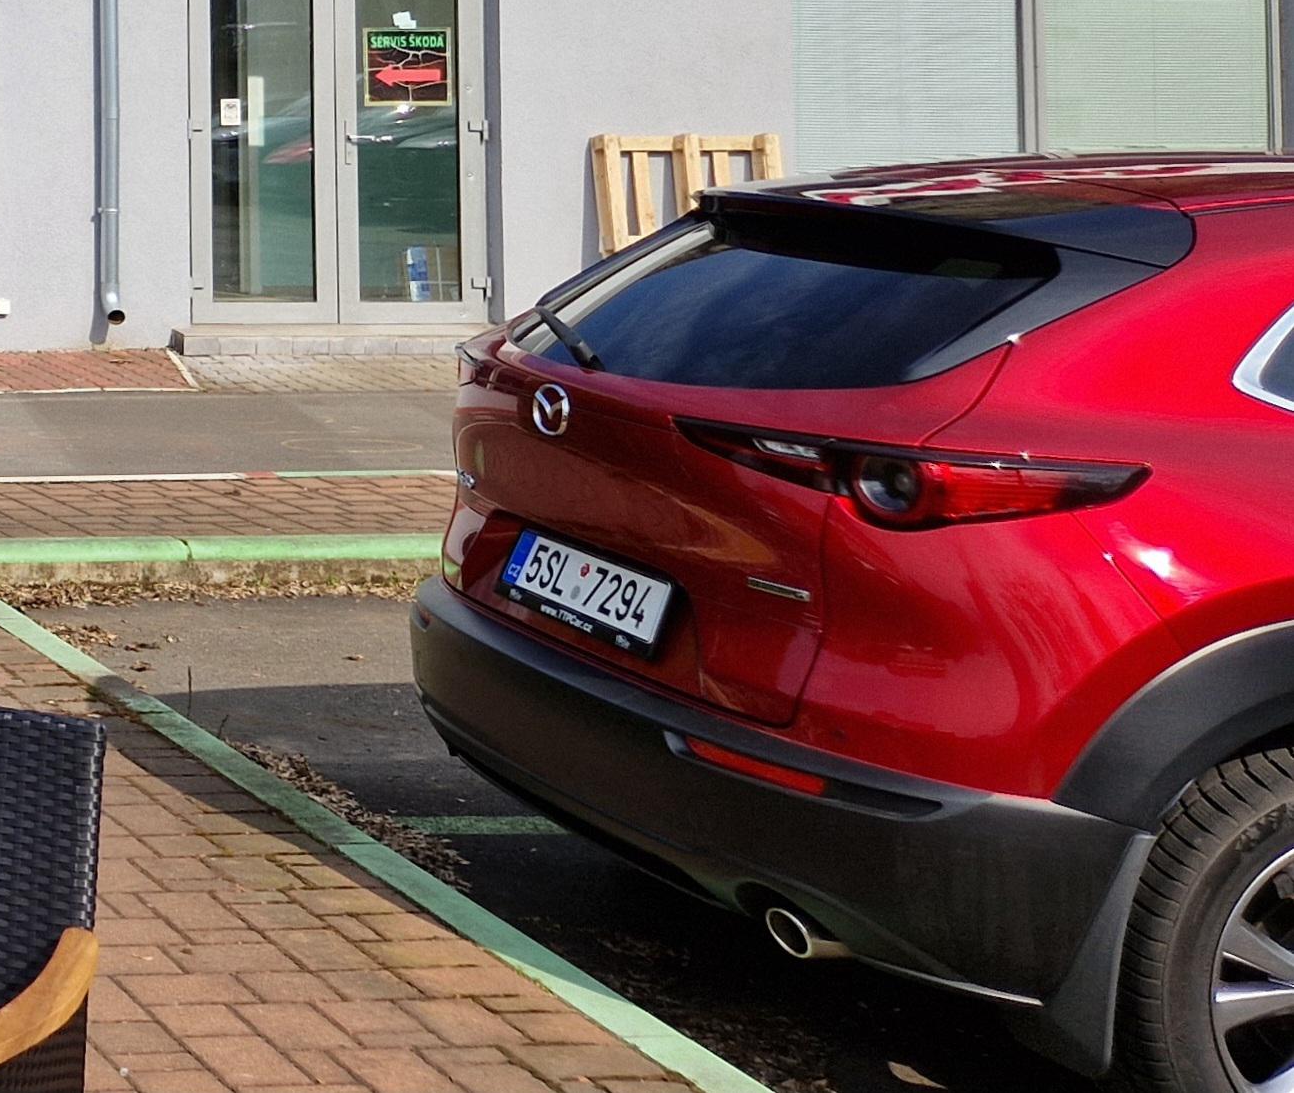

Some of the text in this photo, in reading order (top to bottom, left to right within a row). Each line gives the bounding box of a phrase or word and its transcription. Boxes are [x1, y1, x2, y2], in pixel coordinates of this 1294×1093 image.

[371, 33, 445, 48] SERVIS ŠKODA
[508, 563, 523, 578] CZ
[525, 544, 652, 629] 5SL 7294
